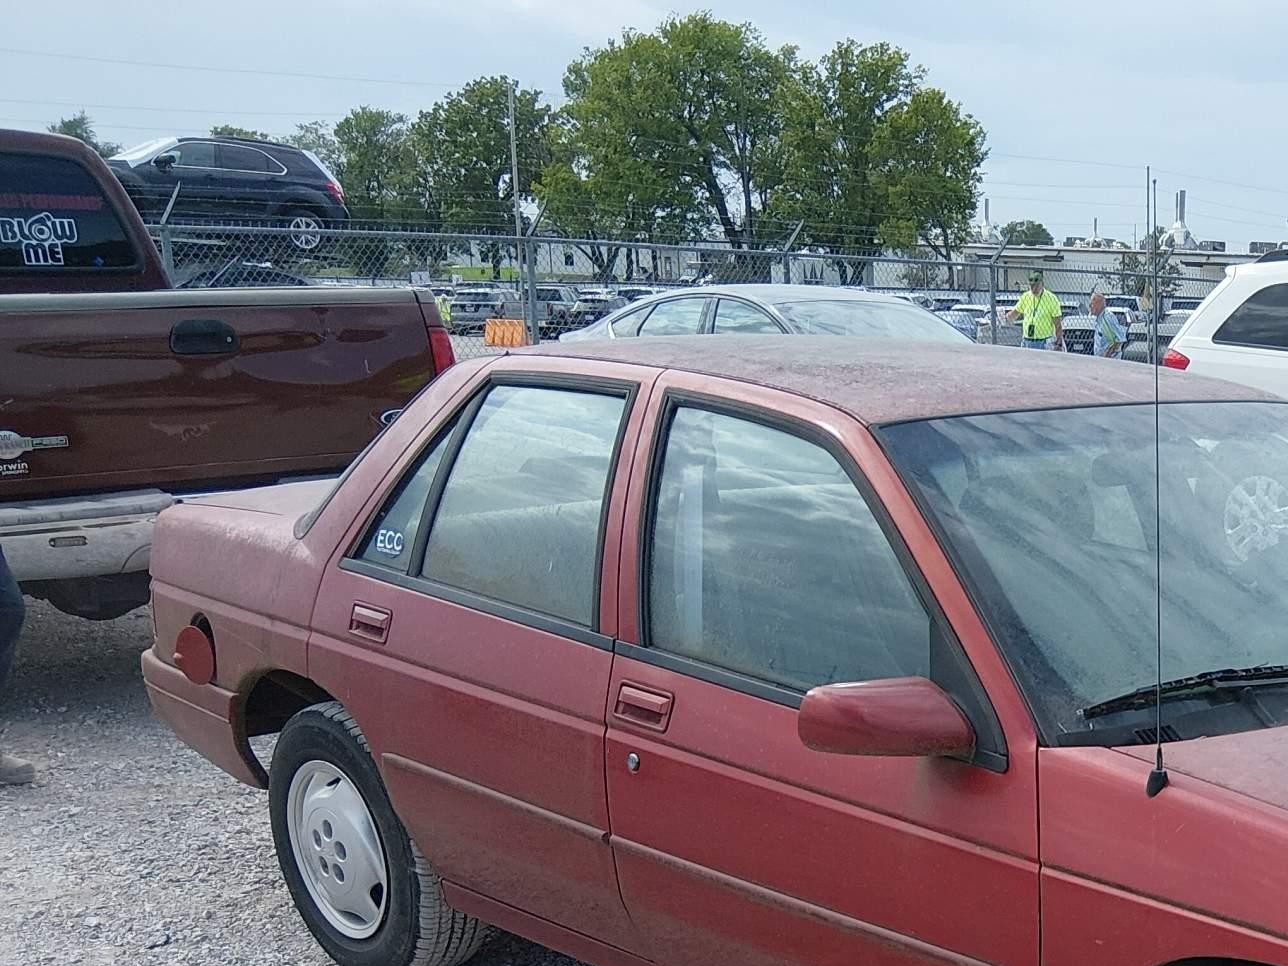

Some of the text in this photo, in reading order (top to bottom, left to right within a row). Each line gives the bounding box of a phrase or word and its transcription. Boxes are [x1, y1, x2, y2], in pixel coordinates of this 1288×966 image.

[0, 213, 77, 243] BLOW
[22, 240, 64, 265] ME
[376, 529, 404, 551] ECC
